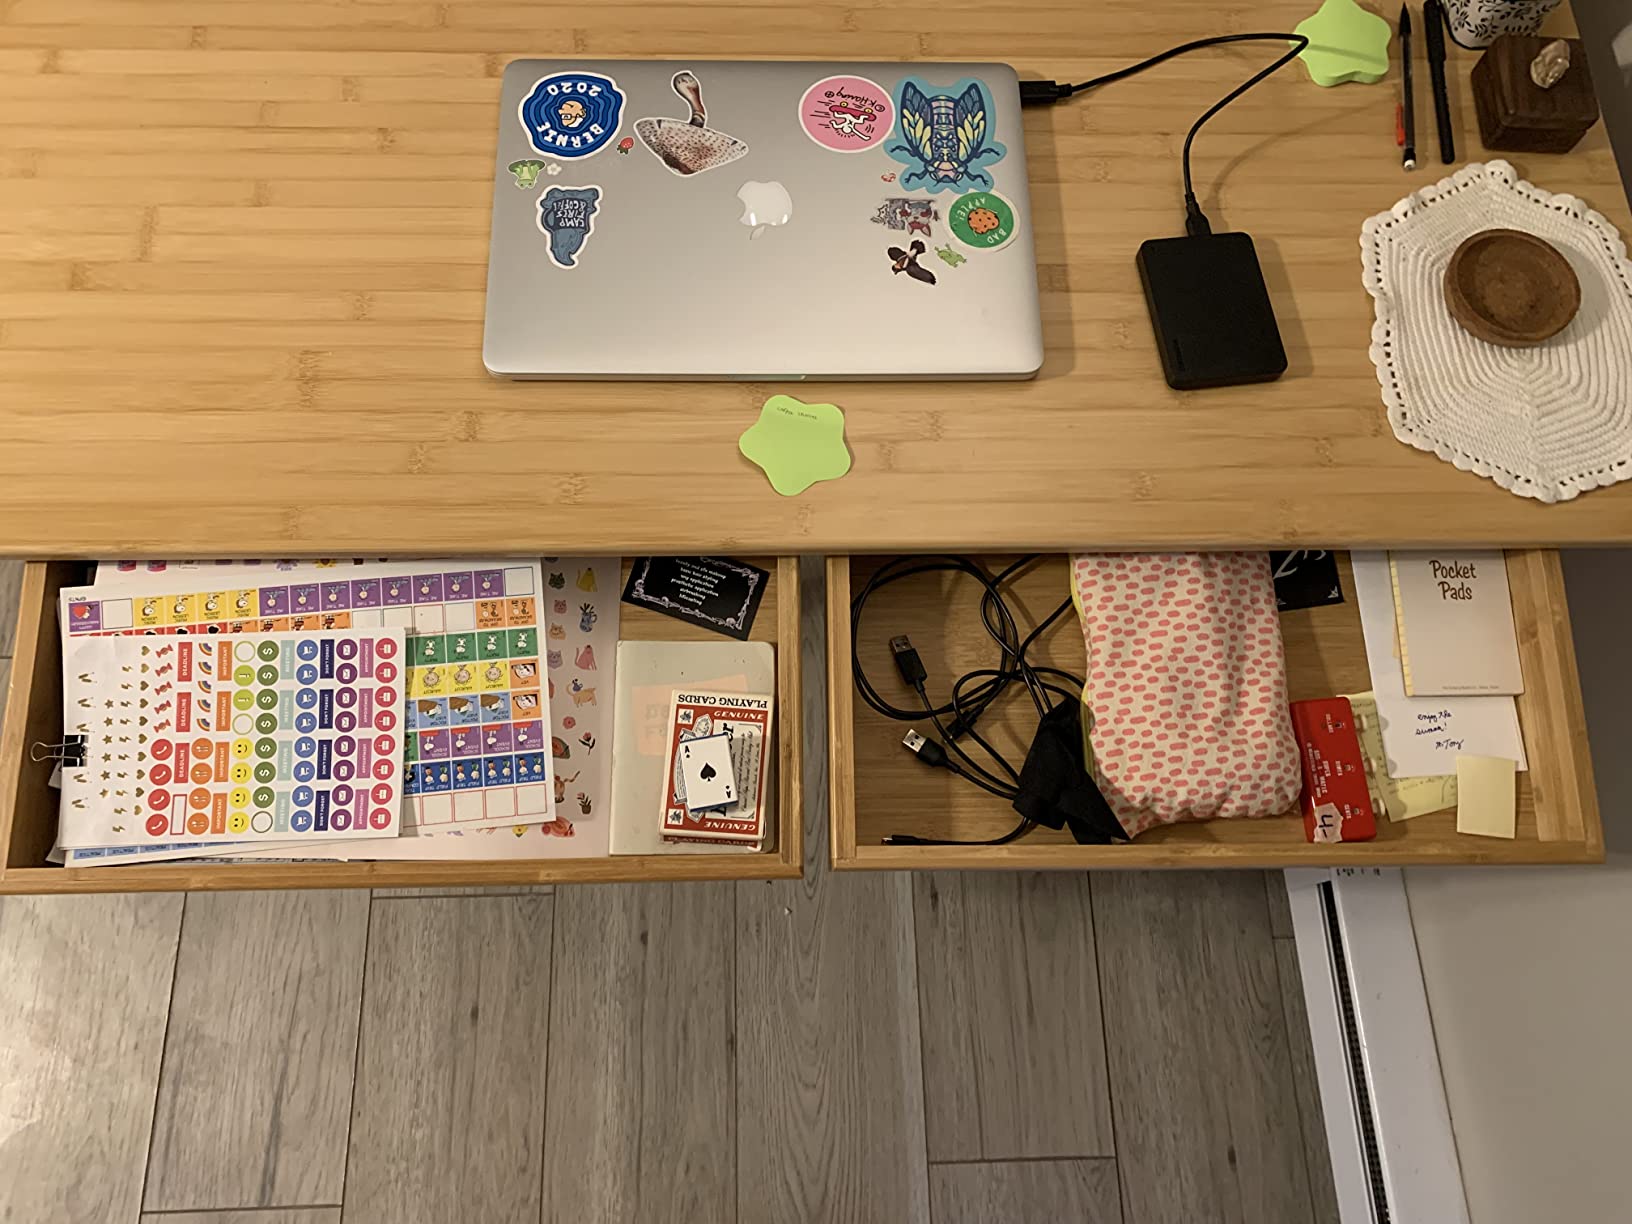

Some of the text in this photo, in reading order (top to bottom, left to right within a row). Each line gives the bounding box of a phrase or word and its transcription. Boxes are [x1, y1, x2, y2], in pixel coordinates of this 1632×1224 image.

[547, 82, 601, 97] 2020
[536, 121, 604, 148] BERNIE
[559, 218, 584, 227] CAMP
[987, 228, 1006, 243] BAD
[1429, 560, 1477, 579] Pocket
[1438, 581, 1472, 601] Pads
[678, 694, 767, 708] PLAYING CARDS
[714, 710, 764, 720] GENUINE
[704, 821, 756, 831] GENUINE
